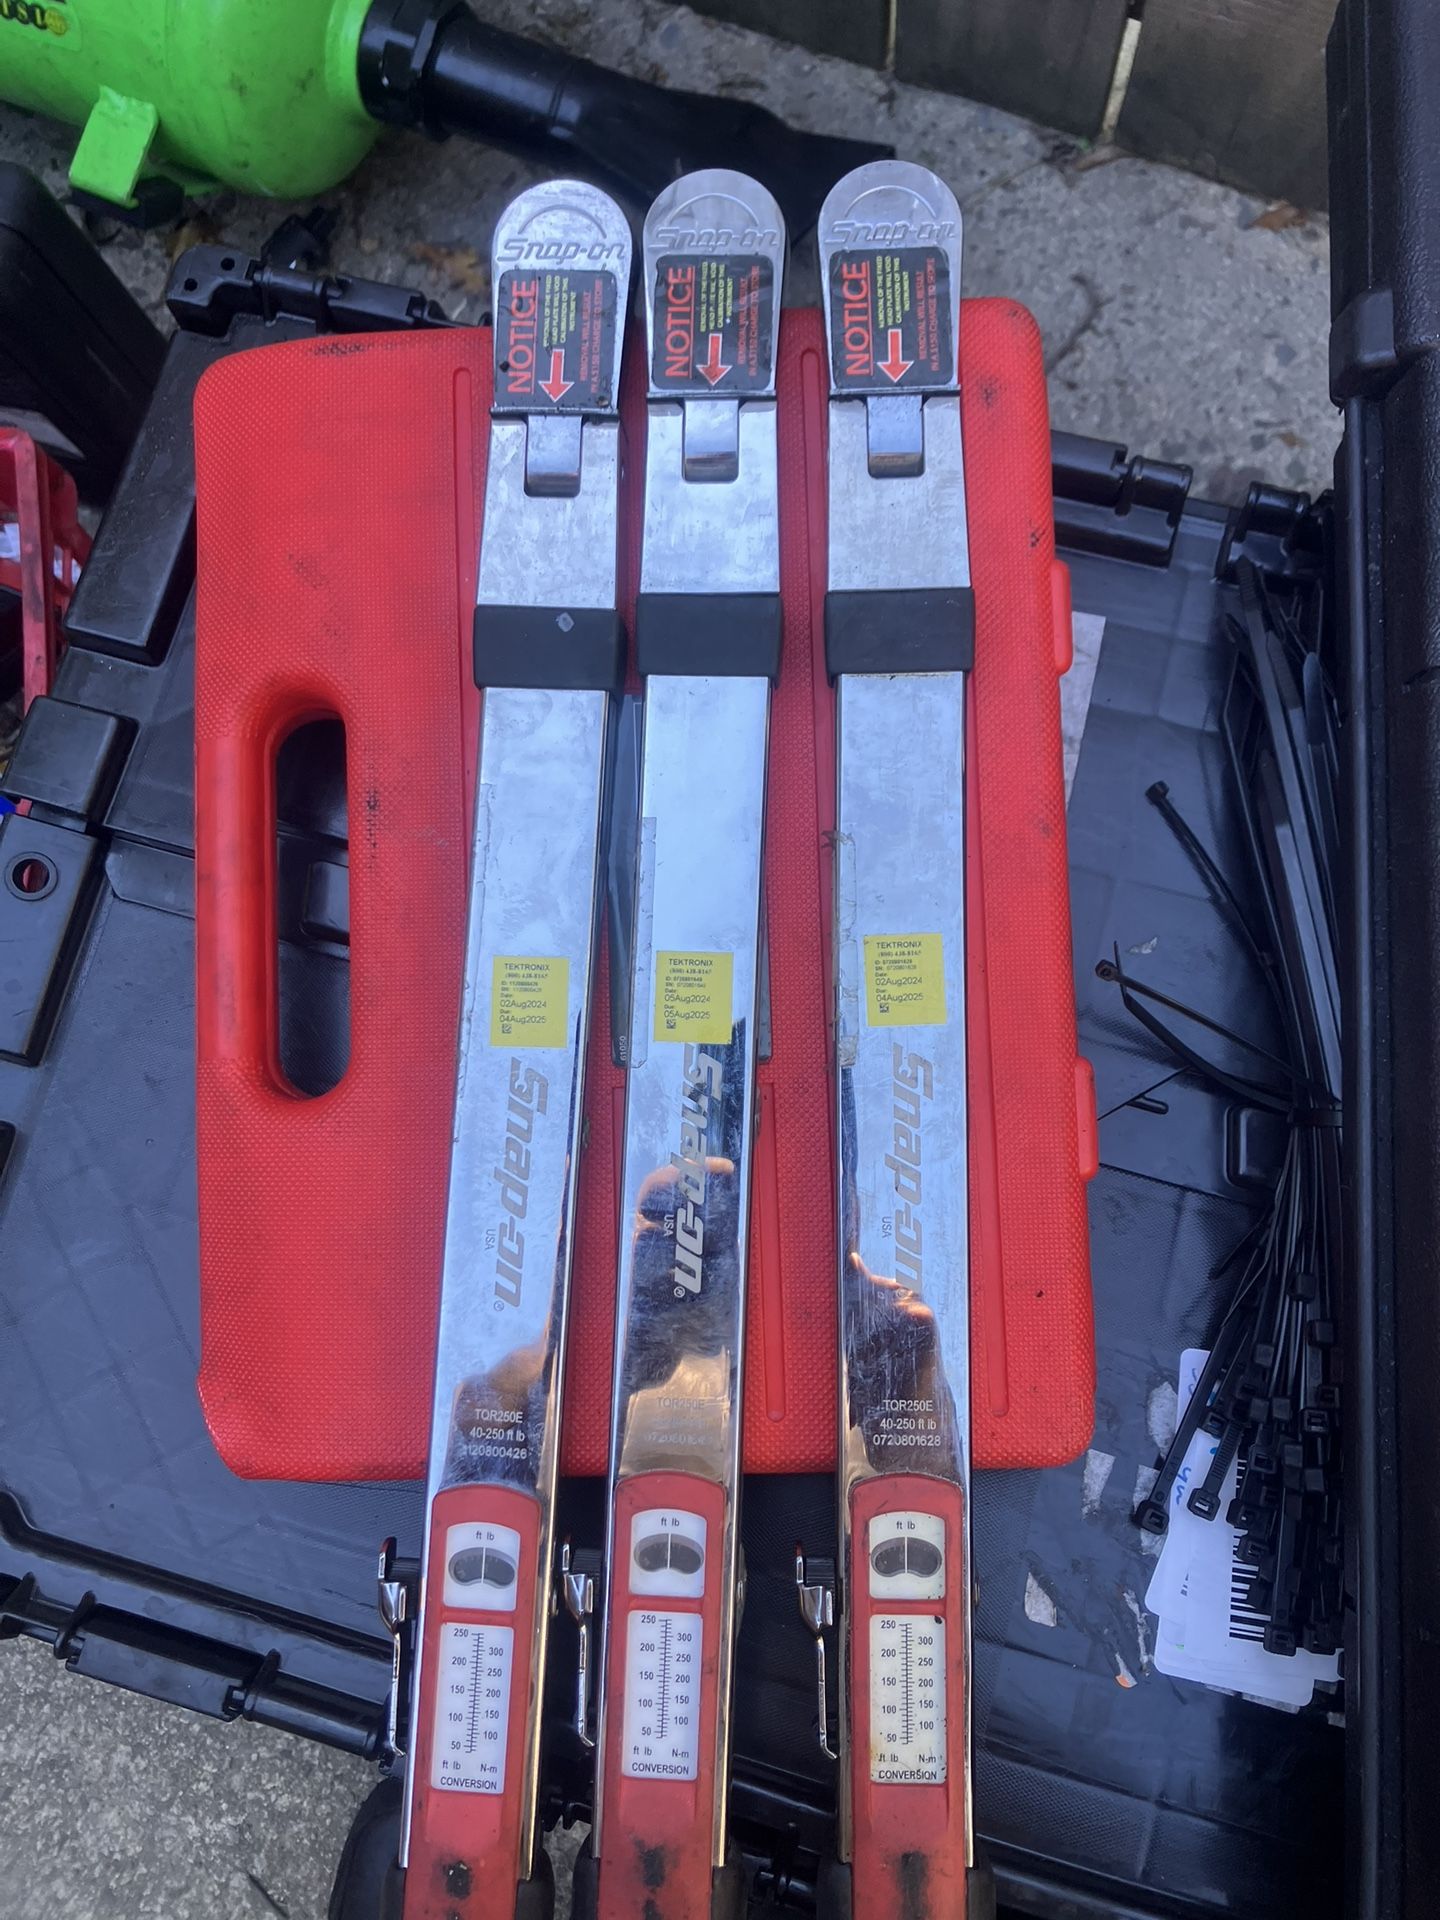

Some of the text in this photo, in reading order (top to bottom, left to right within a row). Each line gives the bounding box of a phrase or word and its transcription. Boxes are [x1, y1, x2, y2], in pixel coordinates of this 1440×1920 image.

[824, 220, 955, 245] Snap-on
[649, 226, 778, 251] Snap-on
[497, 238, 625, 265] Snap-on
[665, 267, 691, 377] NOTICE
[843, 262, 869, 375] NOTICE
[507, 281, 535, 392] NOTICE
[505, 963, 550, 971] TEKTRONIX
[669, 958, 713, 967] TEKTRONIX
[875, 977, 923, 987] 02Aug2024
[664, 994, 711, 1004] 05Aug2024
[875, 993, 924, 1003] 04Aug2025
[500, 1000, 547, 1009] 02Aug2024
[499, 1015, 547, 1024] 04Aug2025
[663, 1010, 711, 1020] 05Aug2025
[663, 1214, 674, 1237] USA
[882, 1215, 892, 1239] USA
[486, 1228, 496, 1251] USA
[656, 1396, 705, 1409] TQR250E
[882, 1399, 933, 1412] TQR250E
[475, 1409, 523, 1423] TQR250E
[880, 1418, 937, 1430] 40-250 ft lb
[469, 1427, 525, 1442] 40-250 ft lb
[872, 1434, 941, 1447] 0720801628
[661, 1517, 680, 1527] ft lb
[896, 1520, 916, 1530] ft lb
[475, 1530, 495, 1541] ft lb
[641, 1615, 656, 1624] 250
[881, 1620, 896, 1629] 250
[453, 1628, 469, 1637] 250
[676, 1632, 692, 1642] 300
[918, 1636, 933, 1646] 300
[488, 1647, 504, 1656] 300
[640, 1643, 655, 1652] 200
[676, 1653, 691, 1663] 250
[881, 1648, 896, 1658] 200
[452, 1656, 467, 1666] 200
[918, 1658, 933, 1667] 250
[487, 1668, 502, 1677] 250
[640, 1671, 654, 1680] 150
[675, 1673, 690, 1684] 200
[882, 1677, 896, 1686] 150
[918, 1678, 934, 1688] 200
[450, 1685, 465, 1694] 150
[486, 1688, 501, 1698] 200
[638, 1698, 653, 1708] 100
[675, 1694, 690, 1704] 150
[882, 1704, 896, 1714] 100
[918, 1700, 934, 1709] 150
[448, 1713, 463, 1722] 100
[484, 1710, 500, 1719] 150
[674, 1716, 688, 1726] 100
[642, 1727, 652, 1736] 50
[919, 1722, 934, 1731] 100
[483, 1731, 498, 1740] 100
[886, 1734, 897, 1743] 50
[450, 1740, 462, 1750] 50
[633, 1745, 653, 1757] ft lb
[671, 1748, 689, 1759] N-m
[879, 1753, 899, 1764] ft lb
[918, 1754, 937, 1764] N-m
[442, 1760, 461, 1770] ft lb
[480, 1764, 498, 1774] N-m
[632, 1762, 689, 1775] CONVERSION
[878, 1768, 937, 1780] CONVERSION
[440, 1776, 498, 1790] CONVERSION
